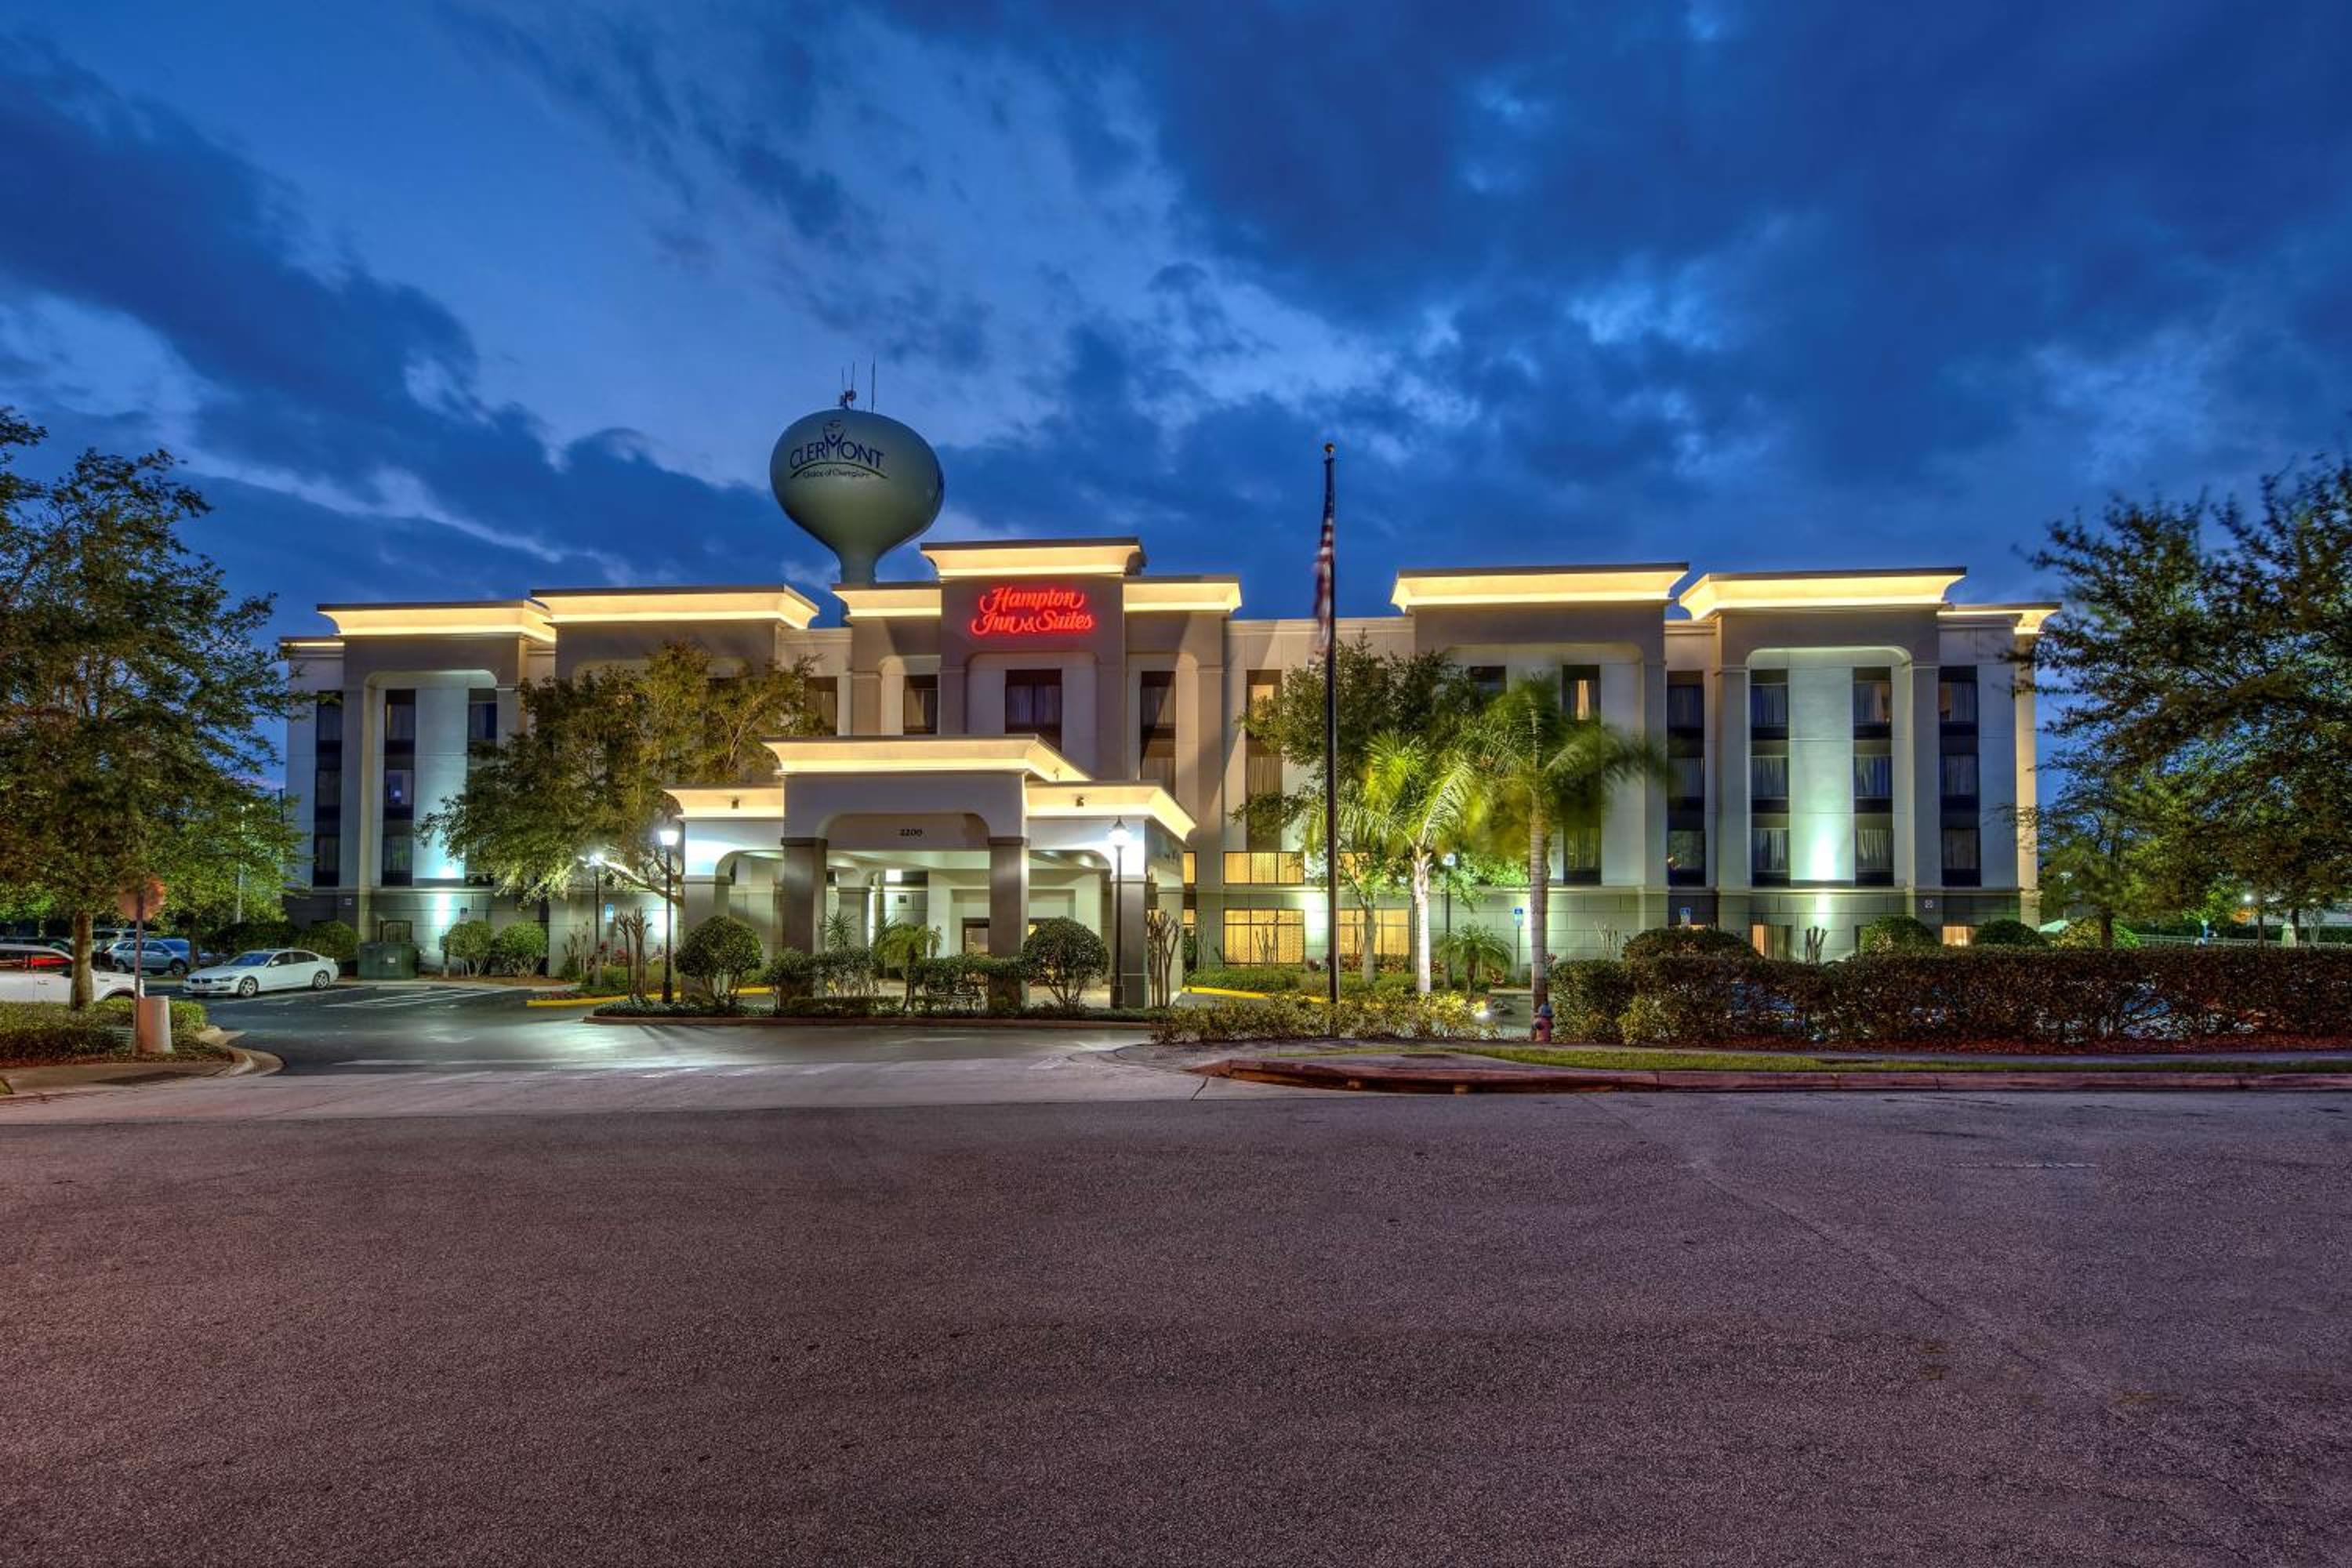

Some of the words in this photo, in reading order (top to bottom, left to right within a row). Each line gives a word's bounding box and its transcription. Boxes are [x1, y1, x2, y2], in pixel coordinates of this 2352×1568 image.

[789, 429, 885, 470] CLERMONT
[980, 587, 1084, 613] Hampton
[971, 611, 1024, 635] Inn
[1023, 617, 1037, 633] &
[1036, 609, 1094, 631] Suites
